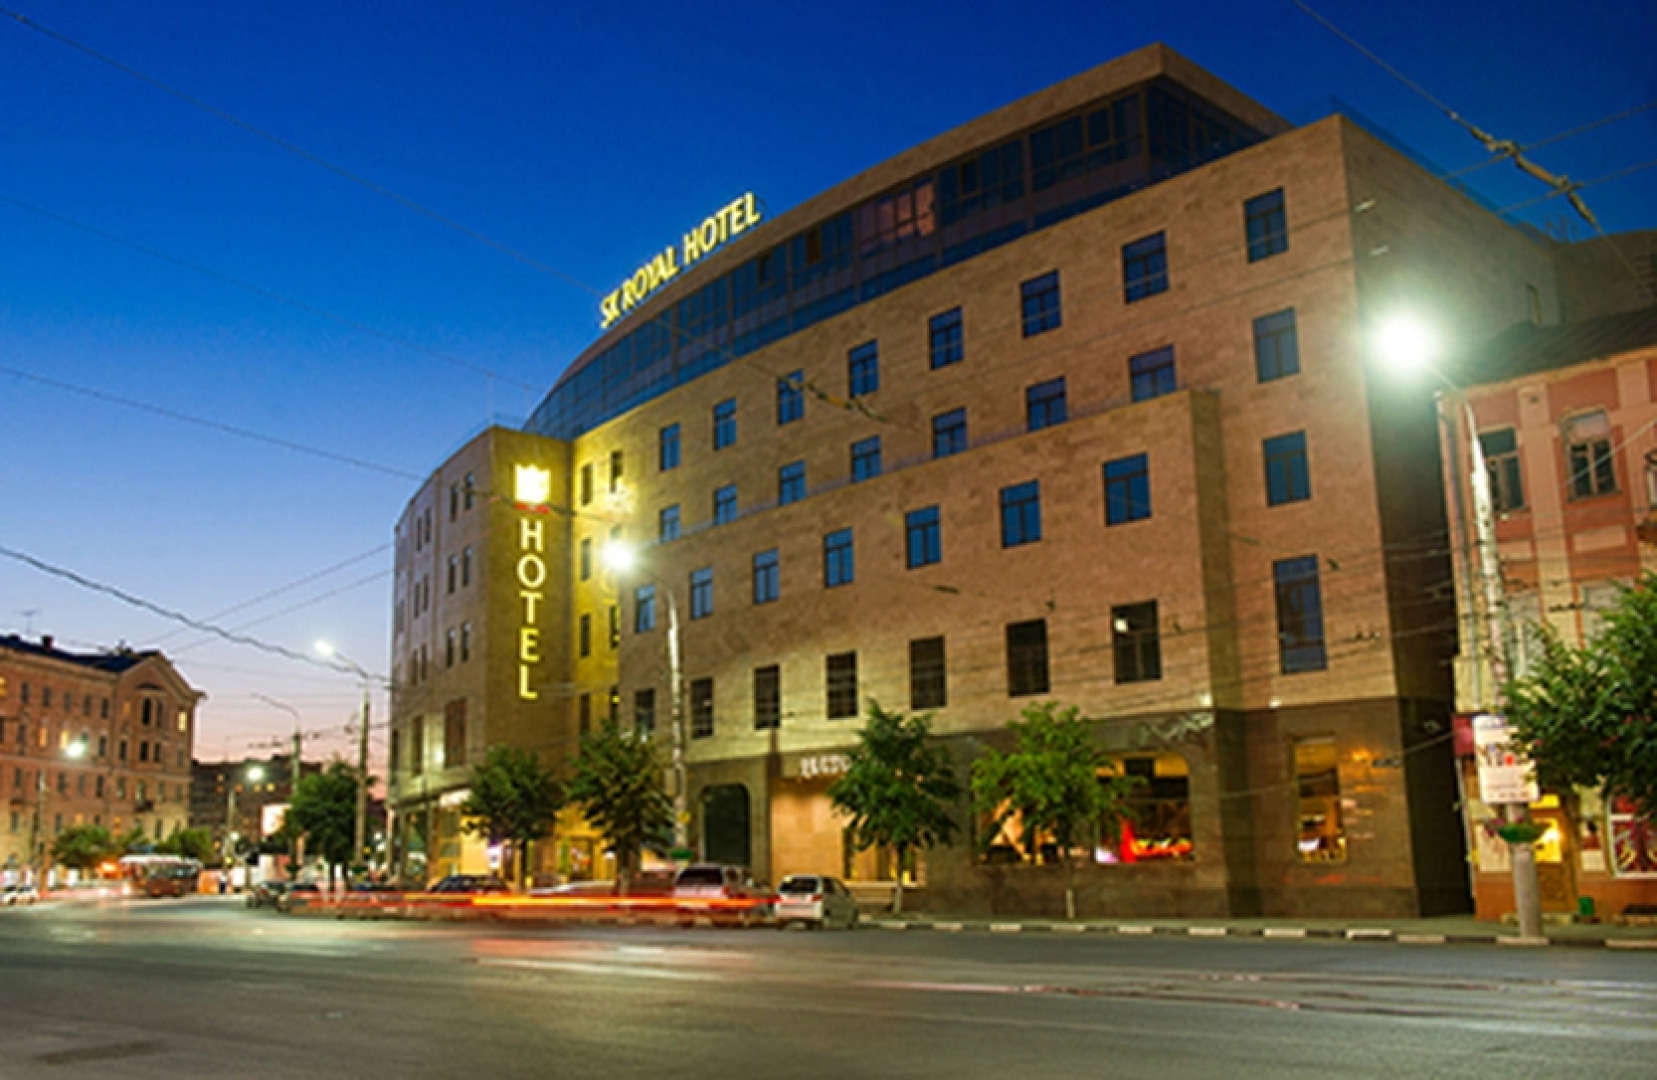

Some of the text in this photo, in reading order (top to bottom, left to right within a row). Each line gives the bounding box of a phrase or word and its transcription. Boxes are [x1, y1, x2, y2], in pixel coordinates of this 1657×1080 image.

[621, 246, 681, 311] ROYAL
[683, 190, 761, 266] HOTEL
[516, 517, 547, 700] HOTEL
